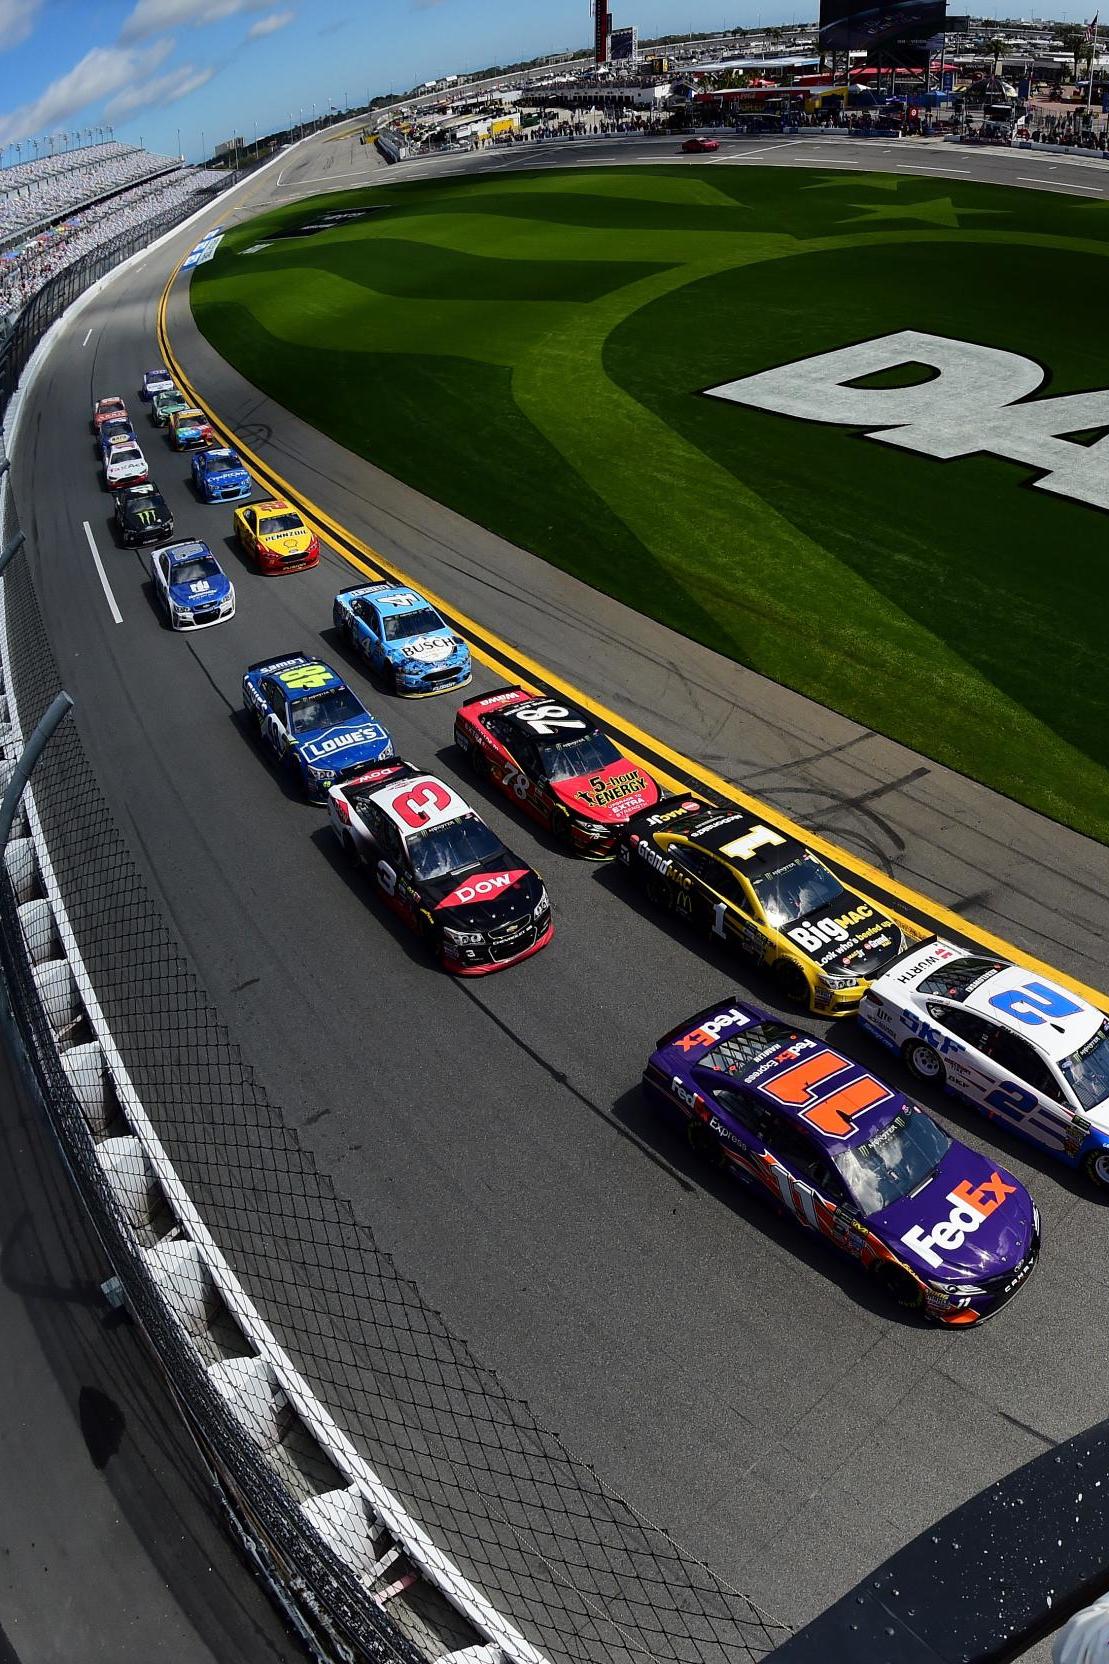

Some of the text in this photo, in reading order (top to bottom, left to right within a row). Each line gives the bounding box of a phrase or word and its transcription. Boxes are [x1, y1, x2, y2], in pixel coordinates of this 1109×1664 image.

[401, 637, 456, 657] BUSCH
[516, 705, 587, 735] 78
[309, 728, 377, 756] LOWE'S
[502, 761, 530, 800] 78
[589, 770, 640, 792] 5-hour
[596, 779, 648, 807] ENERGY
[391, 781, 452, 828] 3
[611, 799, 645, 813] EXTRA
[718, 824, 788, 860] 1
[376, 859, 397, 897] 3
[711, 902, 728, 940] 1
[465, 949, 476, 958] 3
[815, 951, 837, 967] Look
[836, 938, 859, 954] who's
[855, 924, 882, 941] beefed
[988, 982, 1085, 1026] 2
[672, 1009, 751, 1052] FedEx
[900, 1009, 967, 1054] SKF
[744, 1039, 818, 1084] FedEx Express
[757, 1049, 896, 1140] 11
[984, 1081, 1039, 1122] 2
[709, 1116, 747, 1151] Express
[868, 1124, 898, 1149] MONSTER
[900, 1172, 1018, 1268] FedEx
[1004, 1257, 1035, 1292] CAMRY
[956, 1297, 971, 1309] 11
